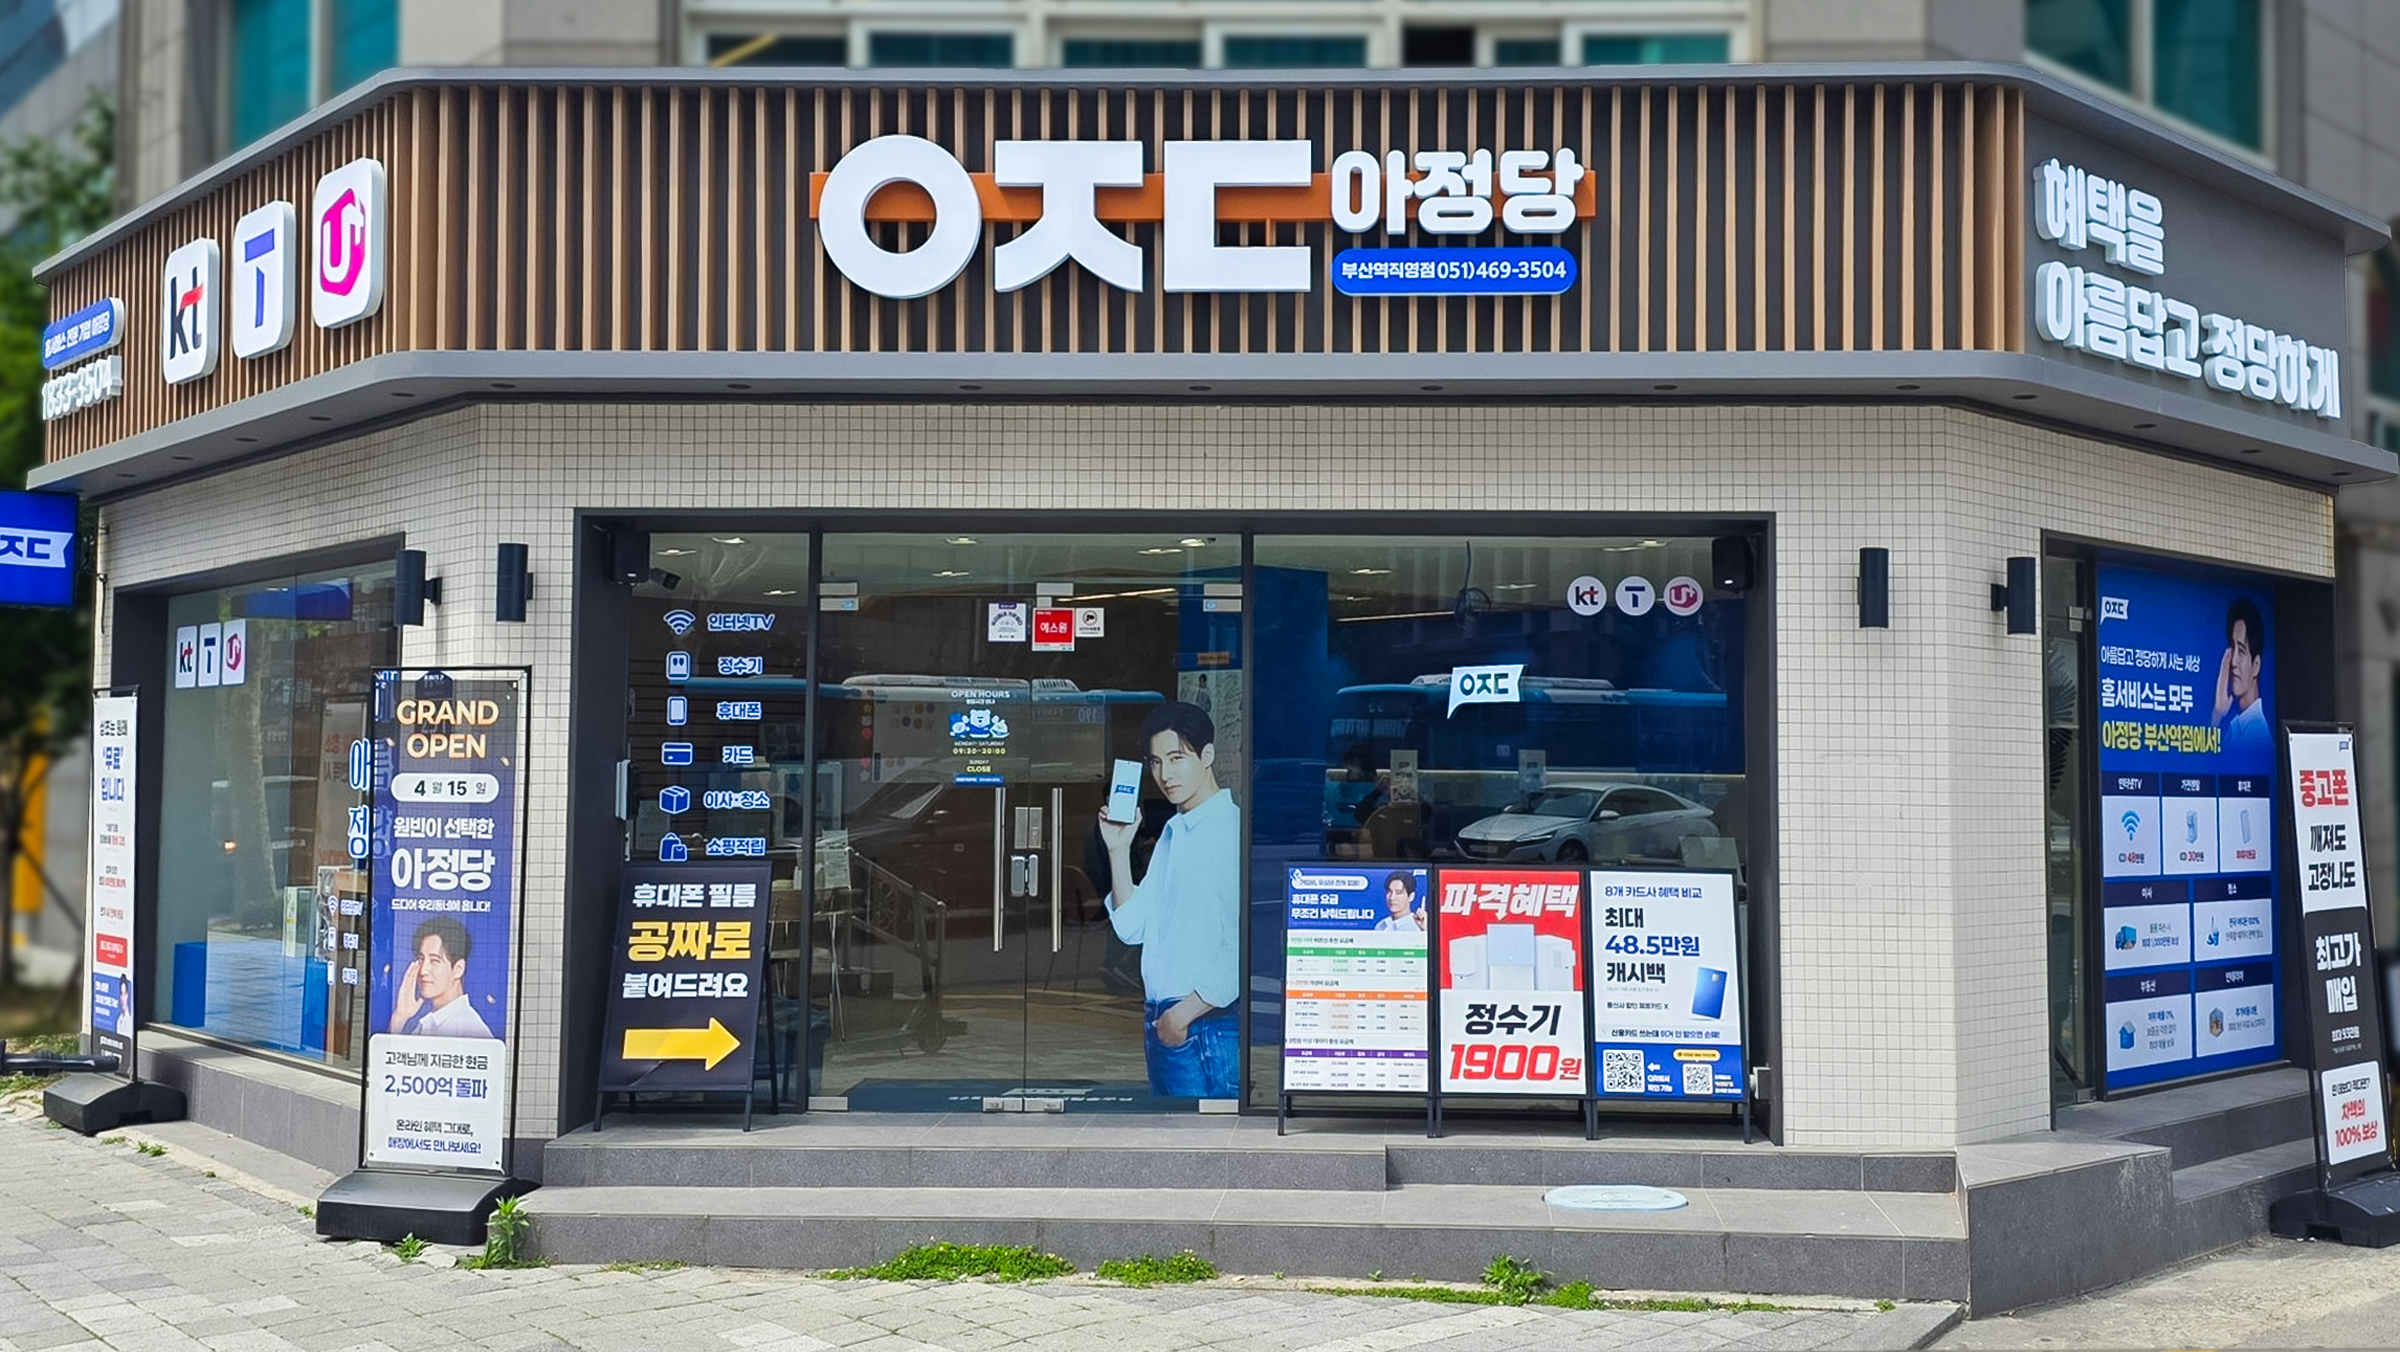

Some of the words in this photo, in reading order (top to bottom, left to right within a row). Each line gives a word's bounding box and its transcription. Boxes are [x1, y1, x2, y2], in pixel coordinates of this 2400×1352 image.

[1330, 146, 1584, 236] 아정당
[2036, 158, 2164, 275] 혜택을
[245, 228, 275, 329] T
[1342, 262, 1435, 279] 부산역직영점
[1437, 261, 1567, 279] 051)469-3504
[169, 266, 203, 360] kt
[2035, 260, 2202, 379] 아름답고
[2201, 312, 2340, 419] 정당하게
[42, 355, 117, 420] 1833-3504
[1575, 586, 1598, 606] kt
[1625, 586, 1645, 608] T
[707, 613, 775, 632] 인터넷TV
[1040, 622, 1067, 633] 에스원
[180, 641, 193, 673] kt
[204, 637, 216, 674] T
[718, 657, 763, 675] 정수기
[2101, 646, 2134, 666] 아름답고
[2135, 649, 2167, 670] 정당하게
[2168, 653, 2184, 671] 사는
[2185, 655, 2200, 673] 세상
[951, 690, 977, 698] OPEN
[979, 690, 1010, 698] HOURS
[2101, 677, 2166, 712] 홈서비스는
[2168, 684, 2194, 713] 모두
[397, 699, 499, 726] GRAND
[716, 702, 762, 720] 휴대폰
[407, 733, 487, 759] OPEN
[2102, 720, 2142, 750] 아정당
[2144, 724, 2222, 754] 부산역점에서!
[722, 746, 754, 763] 카드
[101, 778, 124, 801] 입니다
[414, 781, 426, 796] 4
[432, 781, 443, 795] 월
[447, 781, 467, 796] 15
[476, 782, 486, 795] 일
[2299, 769, 2349, 807] 중고폰
[394, 818, 442, 838] 원빈이
[444, 818, 494, 839] 선택한
[2310, 824, 2346, 852] 깨져도
[706, 838, 766, 856] 쇼핑적립
[391, 848, 496, 891] 아정당
[2308, 861, 2356, 891] 고장나도
[633, 883, 704, 907] 휴대폰
[709, 884, 756, 907] 필름
[1291, 893, 1319, 905] 휴대폰
[1320, 893, 1338, 905] 요금
[1440, 883, 1579, 920] 파격혜택
[1605, 886, 1623, 897] 8개
[1626, 886, 1657, 897] 카드사
[1658, 887, 1679, 898] 혜택
[1681, 888, 1703, 899] 비교
[391, 899, 417, 911] 드디어
[418, 899, 460, 912] 우리동네에
[461, 899, 491, 913] 옵니다!
[1291, 908, 1318, 920] 무조건
[1320, 908, 1374, 920] 낮춰드립니다
[1605, 907, 1644, 928] 최대
[628, 921, 751, 961] 공짜로
[1605, 935, 1700, 957] 48.5만원
[2316, 932, 2362, 971] 최고가
[1607, 962, 1665, 984] 캐시백
[623, 973, 748, 998] 붙여드려요
[2326, 975, 2358, 1014] 매입
[1465, 1004, 1562, 1036] 정수기
[385, 1052, 428, 1067] 고객님께
[430, 1054, 464, 1069] 지급한
[466, 1055, 488, 1070] 현금
[1449, 1044, 1582, 1080] 1900원
[385, 1075, 452, 1097] 2,500억
[456, 1078, 488, 1099] 돌파
[2341, 1098, 2365, 1120] 차액의
[397, 1119, 422, 1133] 온라인
[424, 1121, 442, 1134] 혜택
[444, 1123, 473, 1136] 그대로,
[2335, 1125, 2361, 1148] 100%
[2362, 1119, 2378, 1141] 보상
[388, 1137, 431, 1151] 매장에서도
[433, 1139, 481, 1154] 만나보세요!
